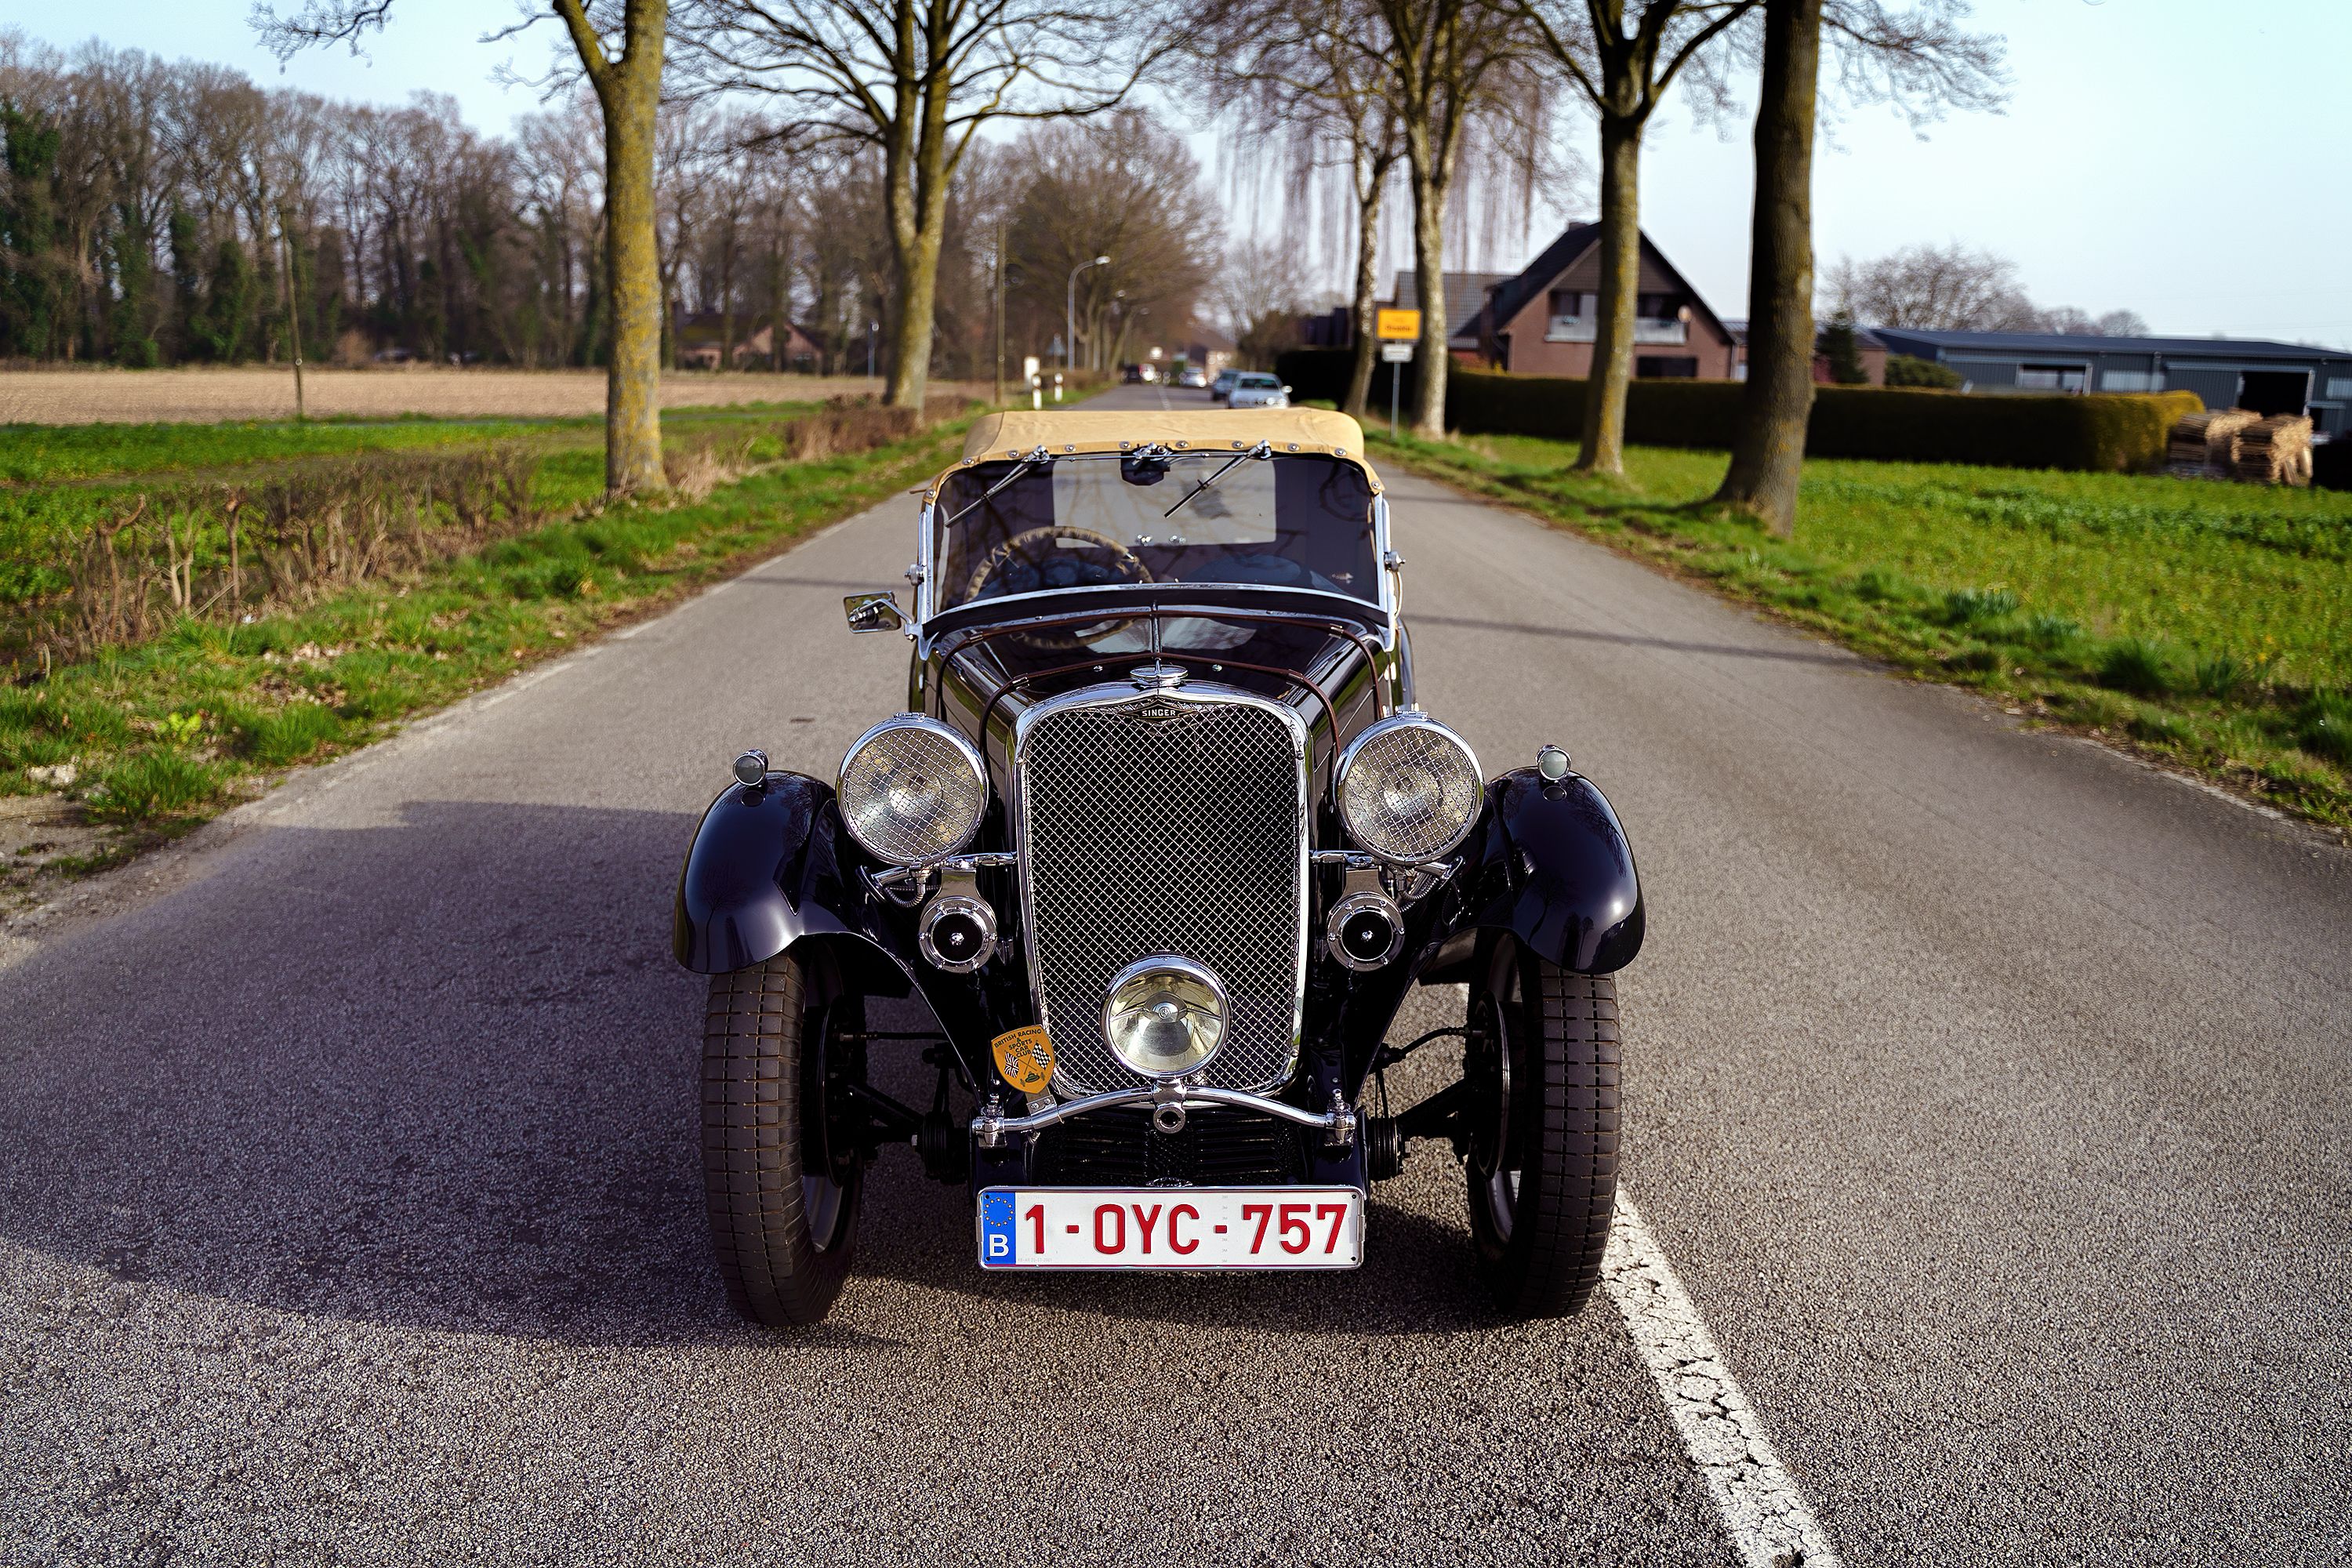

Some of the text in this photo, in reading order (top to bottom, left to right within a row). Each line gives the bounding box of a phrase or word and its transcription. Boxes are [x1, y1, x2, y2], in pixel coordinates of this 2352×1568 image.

[994, 1034, 1016, 1047] BRITISH
[1008, 1039, 1032, 1050] SPORTS
[989, 1234, 1009, 1257] B
